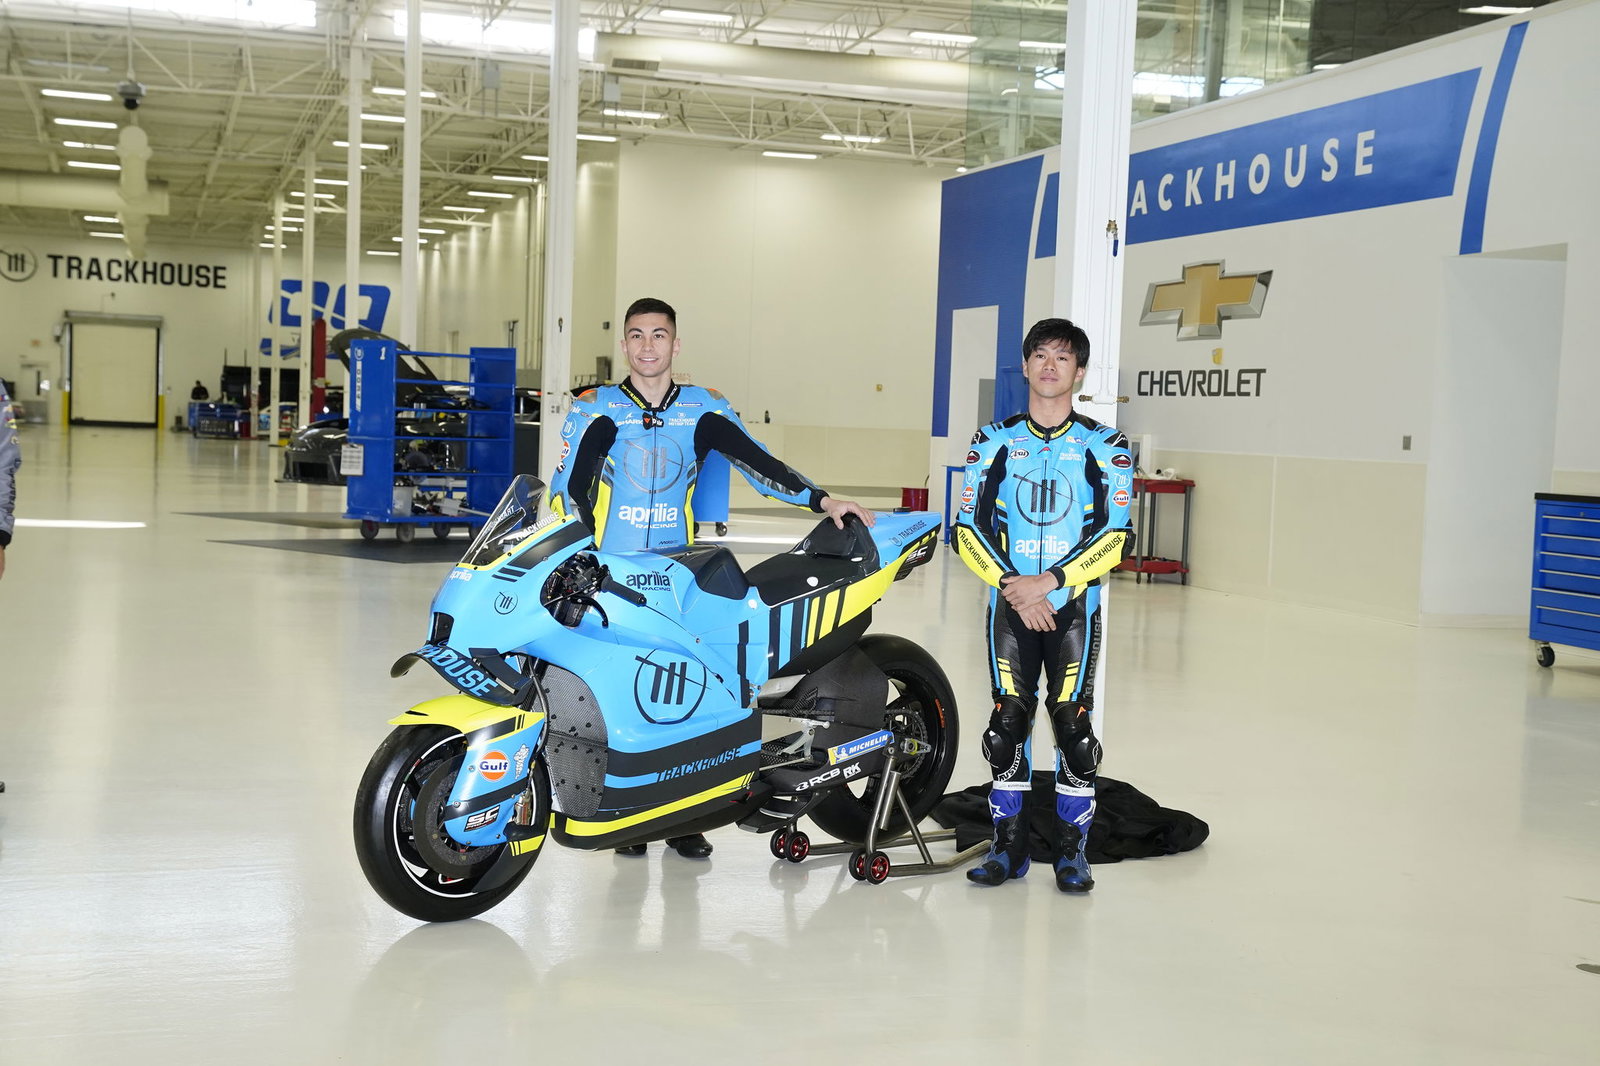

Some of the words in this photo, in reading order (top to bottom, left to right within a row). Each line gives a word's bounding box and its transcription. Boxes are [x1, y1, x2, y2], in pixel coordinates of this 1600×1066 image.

[1130, 130, 1375, 217] ACKHOUSE
[48, 254, 227, 289] TRACKHOUSE
[1137, 368, 1266, 397] CHEVROLET
[618, 502, 678, 524] aprilia
[898, 520, 927, 539] TRACKHOUSE
[958, 528, 990, 573] TRACKHOUSE
[1015, 535, 1070, 557] aprilia
[1080, 534, 1124, 571] TRACKHOUSE
[626, 570, 671, 589] aprilia
[849, 734, 888, 754] MICHELIN
[480, 760, 508, 771] Gulf
[657, 747, 742, 784] TRACKHOUSE
[843, 762, 861, 779] RK
[809, 768, 840, 787] RCB
[468, 806, 500, 824] SC
